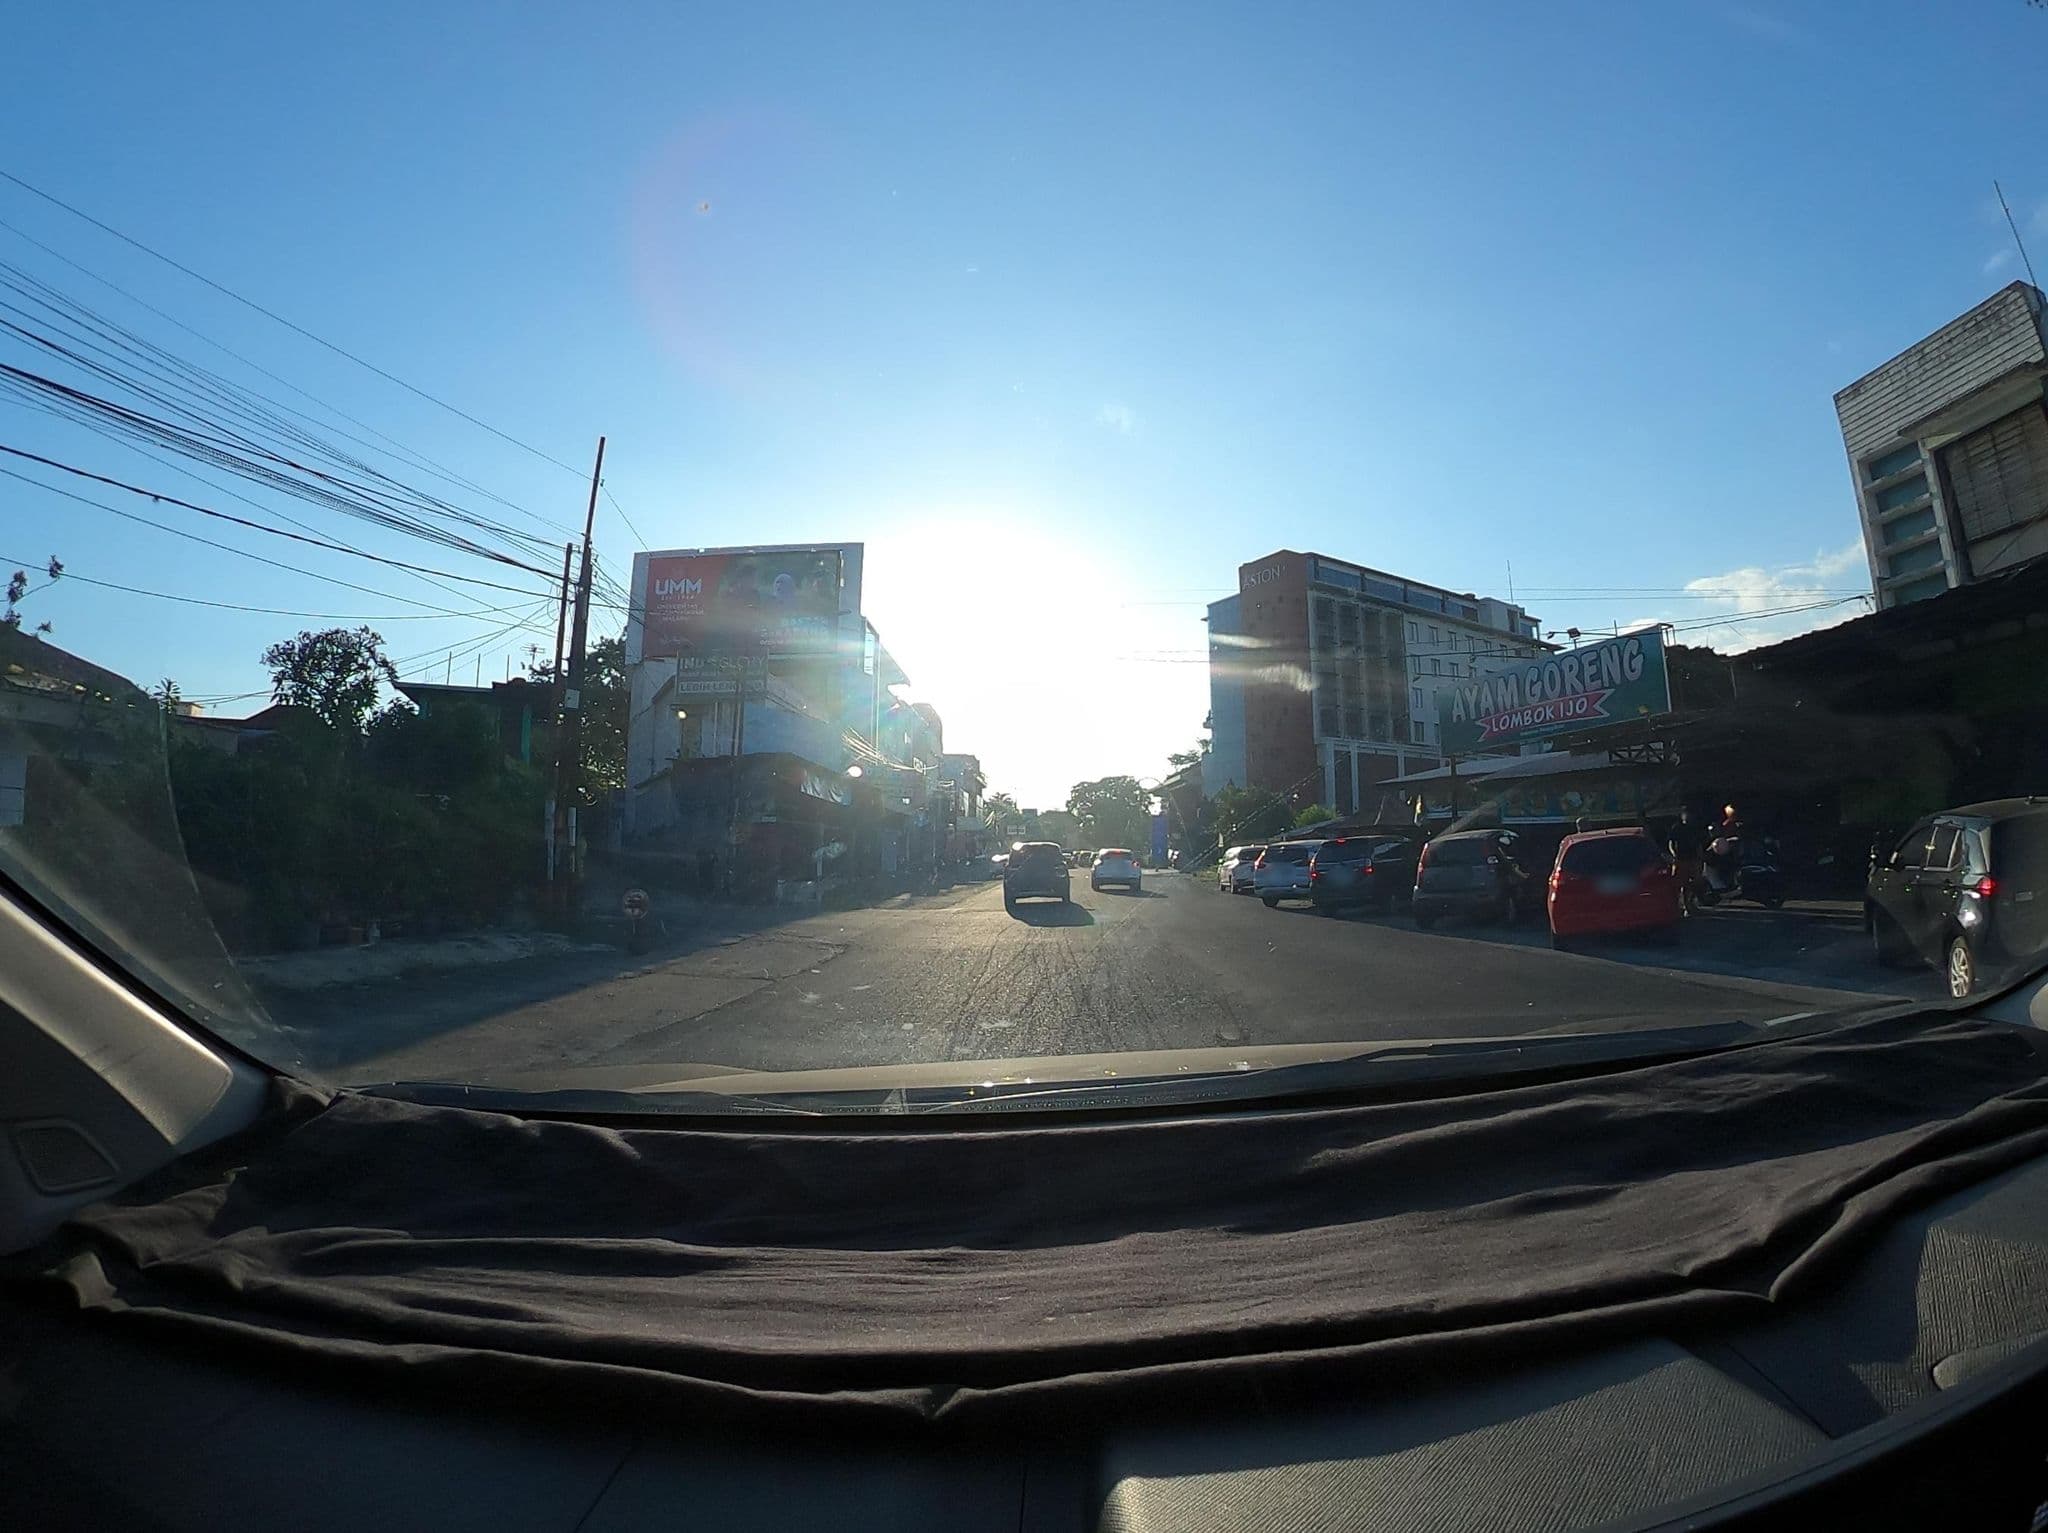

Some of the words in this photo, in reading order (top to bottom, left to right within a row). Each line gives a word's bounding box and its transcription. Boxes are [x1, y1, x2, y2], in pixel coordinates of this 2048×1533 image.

[655, 578, 702, 595] UMM
[1242, 565, 1280, 588] ASTON
[1451, 673, 1519, 723] AYAM
[1524, 638, 1644, 704] GORENG
[1491, 705, 1555, 733] LOMBOK
[1560, 697, 1588, 718] IJO
